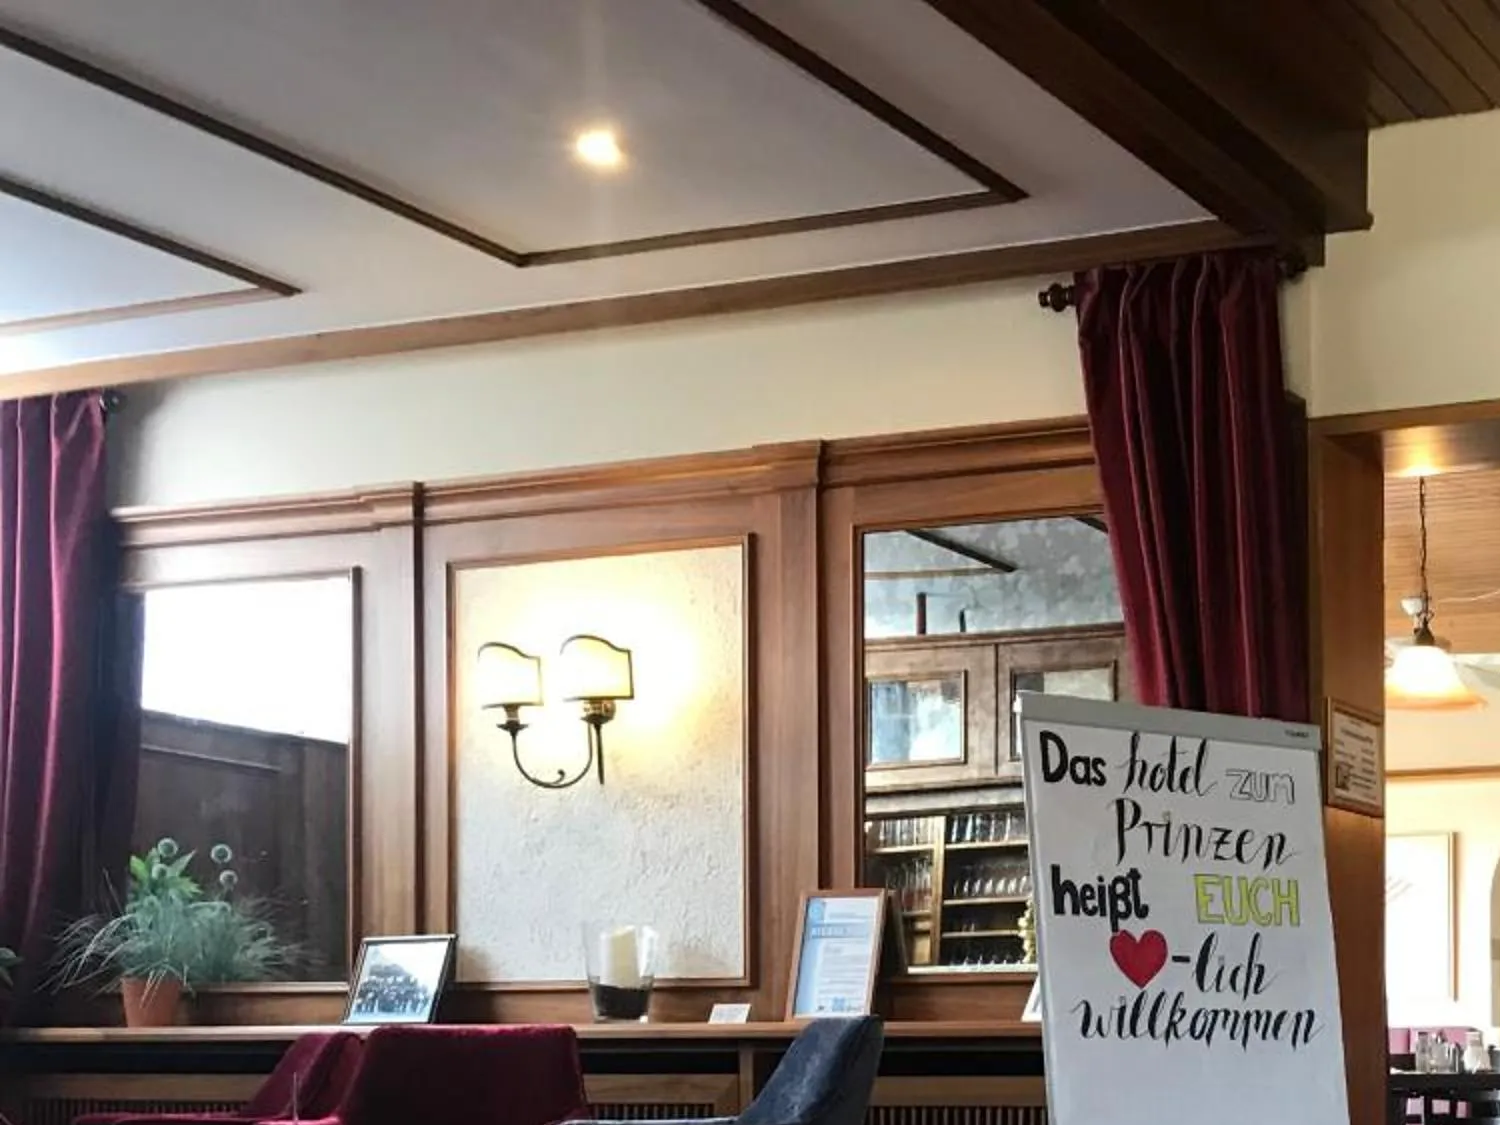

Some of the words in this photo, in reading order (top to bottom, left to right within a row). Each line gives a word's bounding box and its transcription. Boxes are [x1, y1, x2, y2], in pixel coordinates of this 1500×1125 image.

[1039, 730, 1107, 785] Das
[1107, 798, 1294, 870] Prinzen
[1051, 864, 1149, 933] heißt
[1194, 873, 1301, 927] EUCH
[1071, 990, 1324, 1050] willkommen
